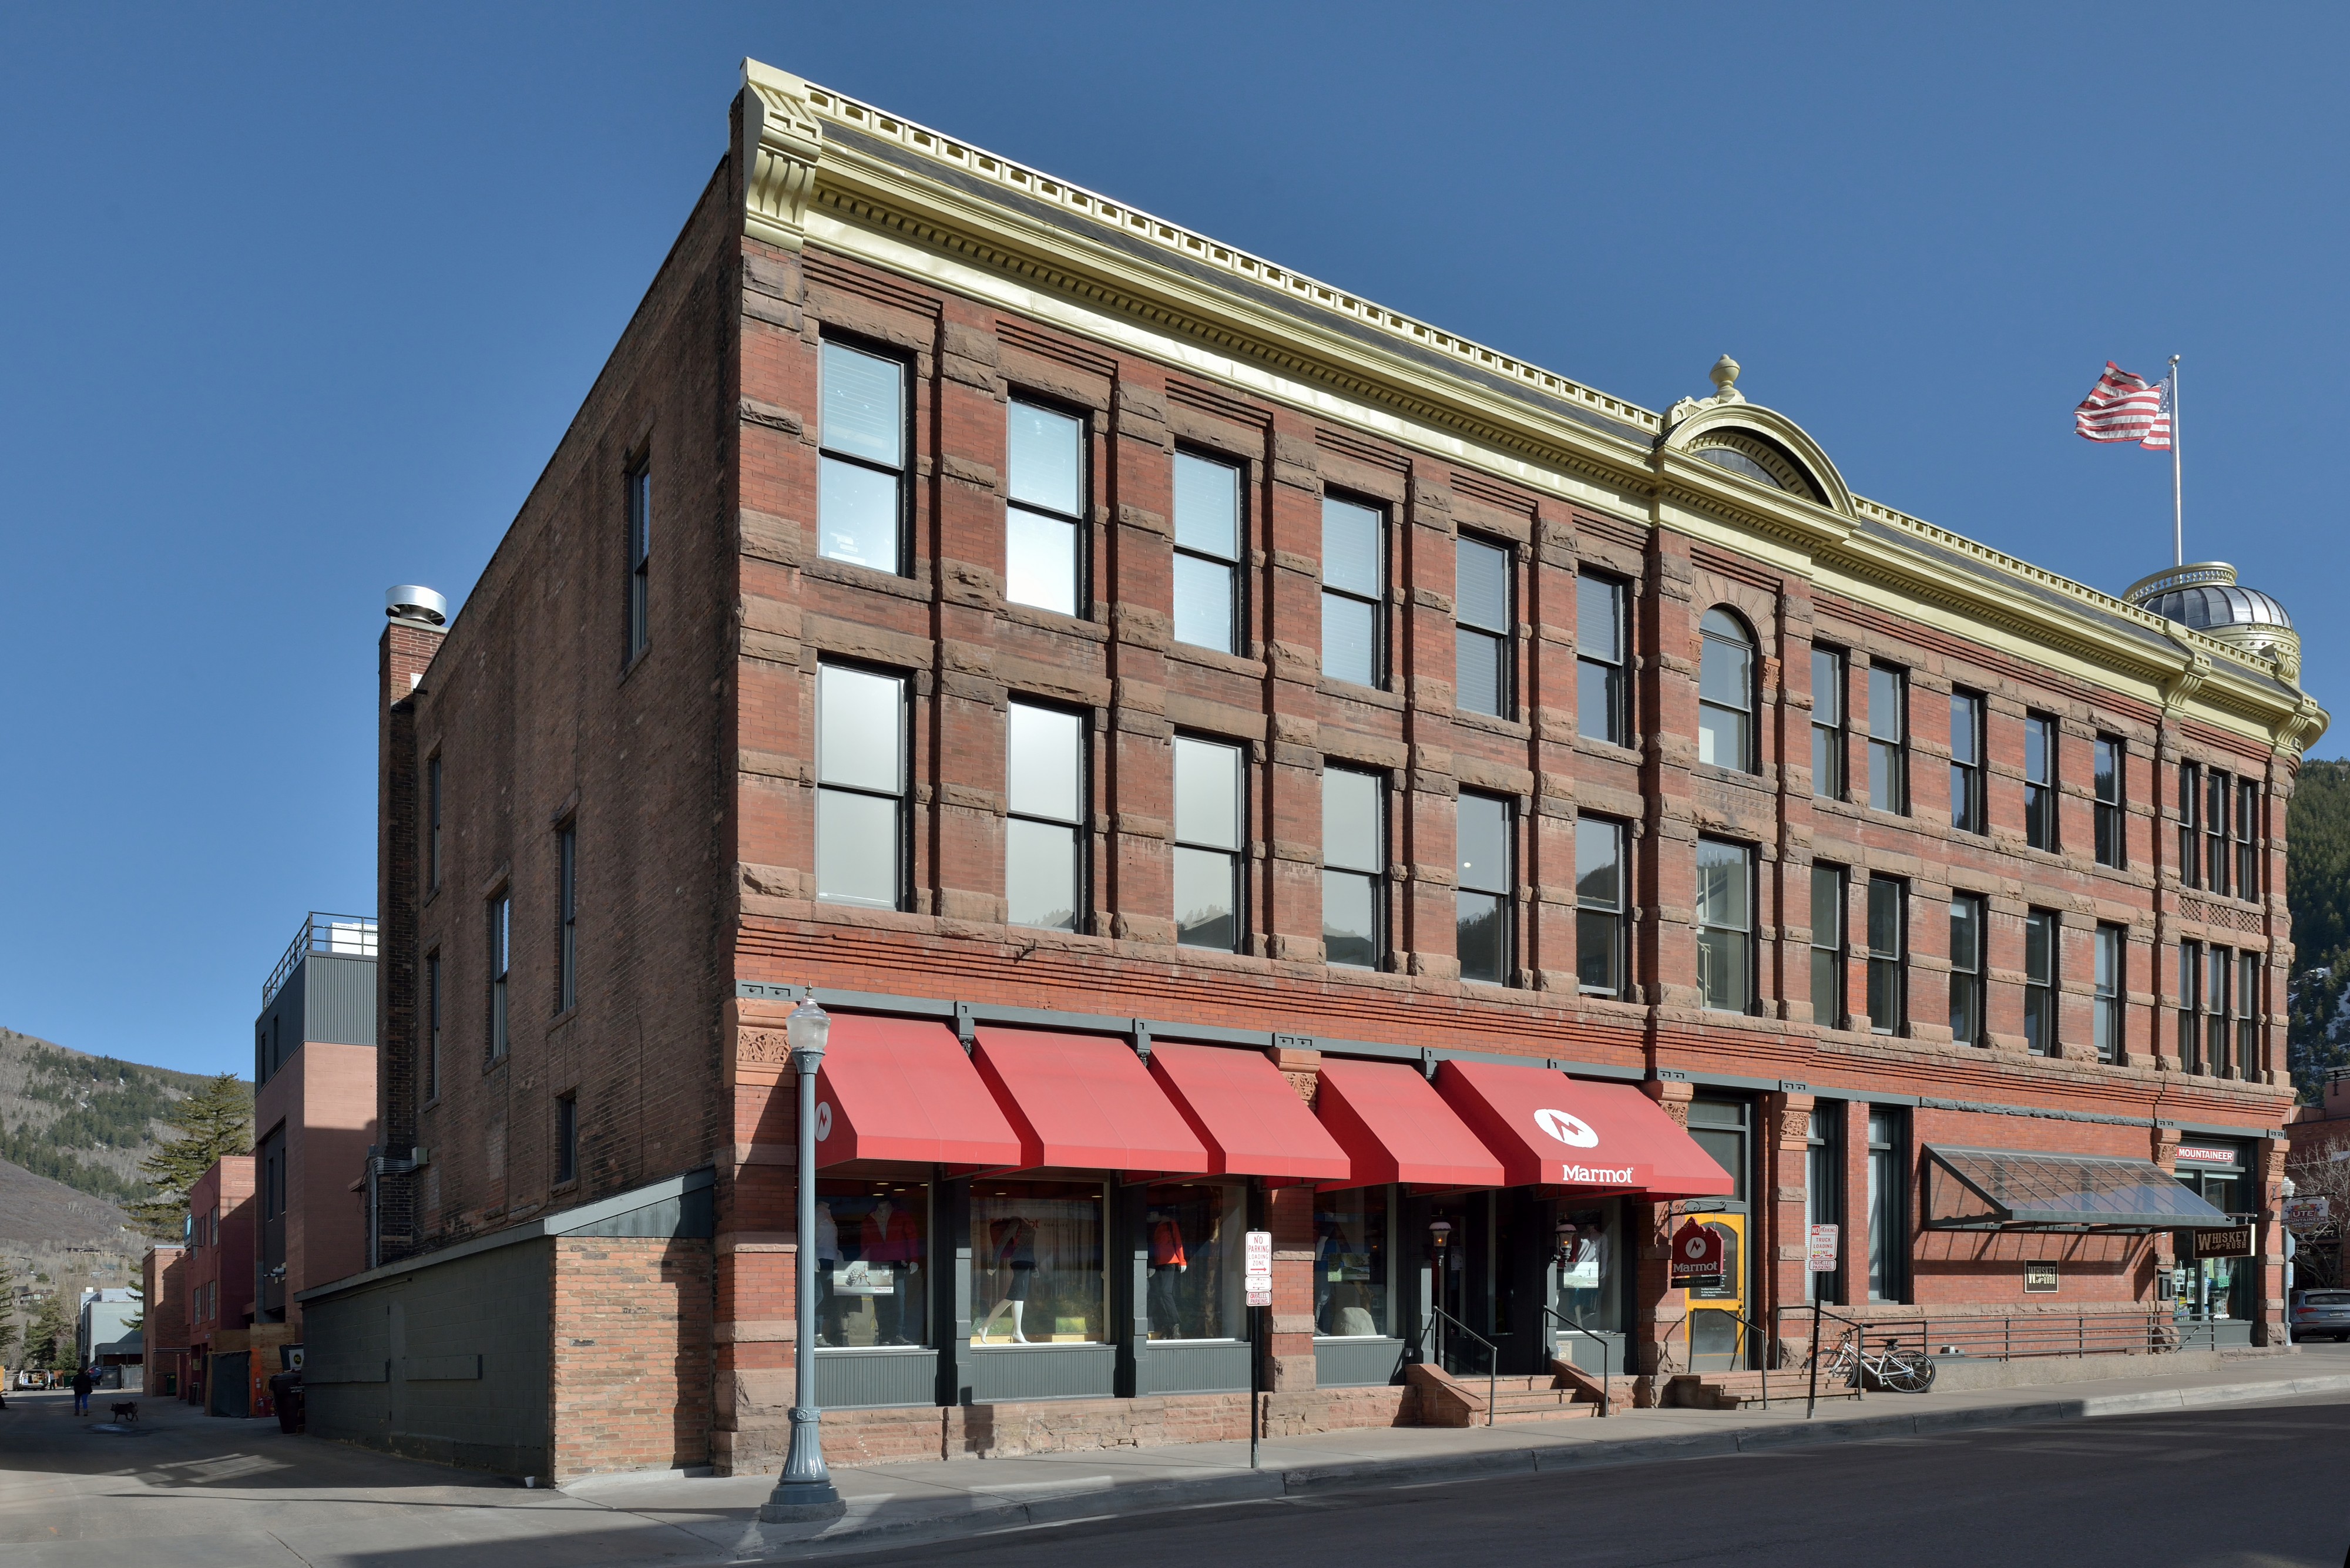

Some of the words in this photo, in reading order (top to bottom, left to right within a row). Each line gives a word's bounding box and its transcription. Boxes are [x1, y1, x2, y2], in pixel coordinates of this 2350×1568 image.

[2178, 1148, 2232, 1160] MOUNTAINEER
[1562, 1164, 1633, 1183] Marmot
[1254, 1236, 1263, 1244] NO
[2197, 1231, 2248, 1251] WHISKEY
[2225, 1241, 2247, 1250] RUSH
[1248, 1245, 1269, 1253] PARKING
[1673, 1261, 1718, 1272] Marmot
[2027, 1266, 2056, 1284] WHISKEY
[2219, 1278, 2228, 1286] SALE
